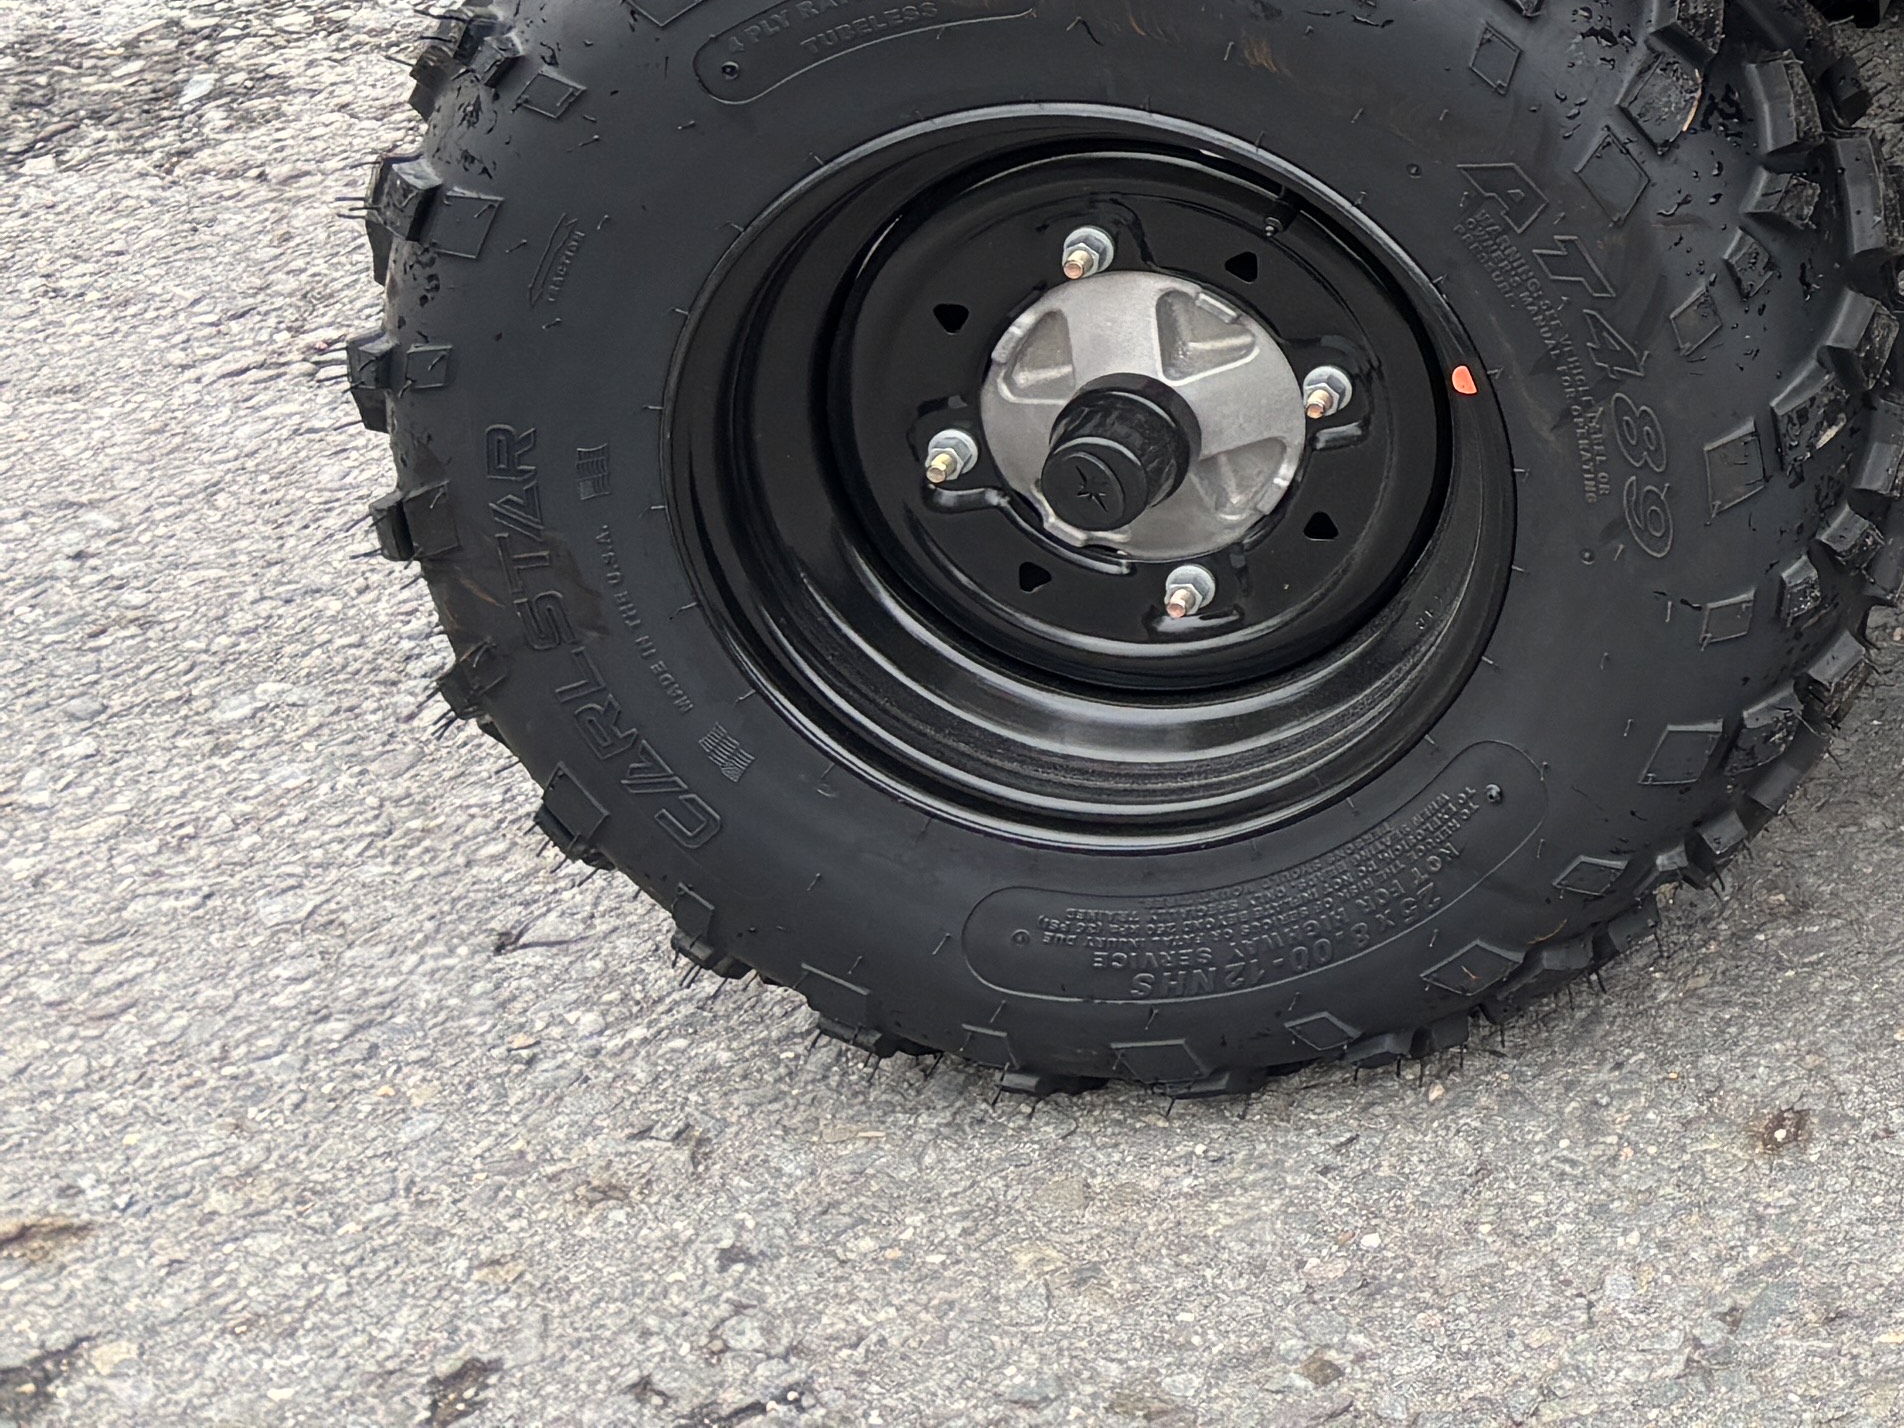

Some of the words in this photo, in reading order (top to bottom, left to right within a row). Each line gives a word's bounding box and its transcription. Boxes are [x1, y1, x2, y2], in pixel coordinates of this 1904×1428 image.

[743, 8, 794, 44] PLY
[485, 421, 726, 856] CARLSTAR
[648, 658, 695, 716] MADE
[1092, 945, 1213, 967] SERVICE
[1128, 965, 1221, 998] NHS
